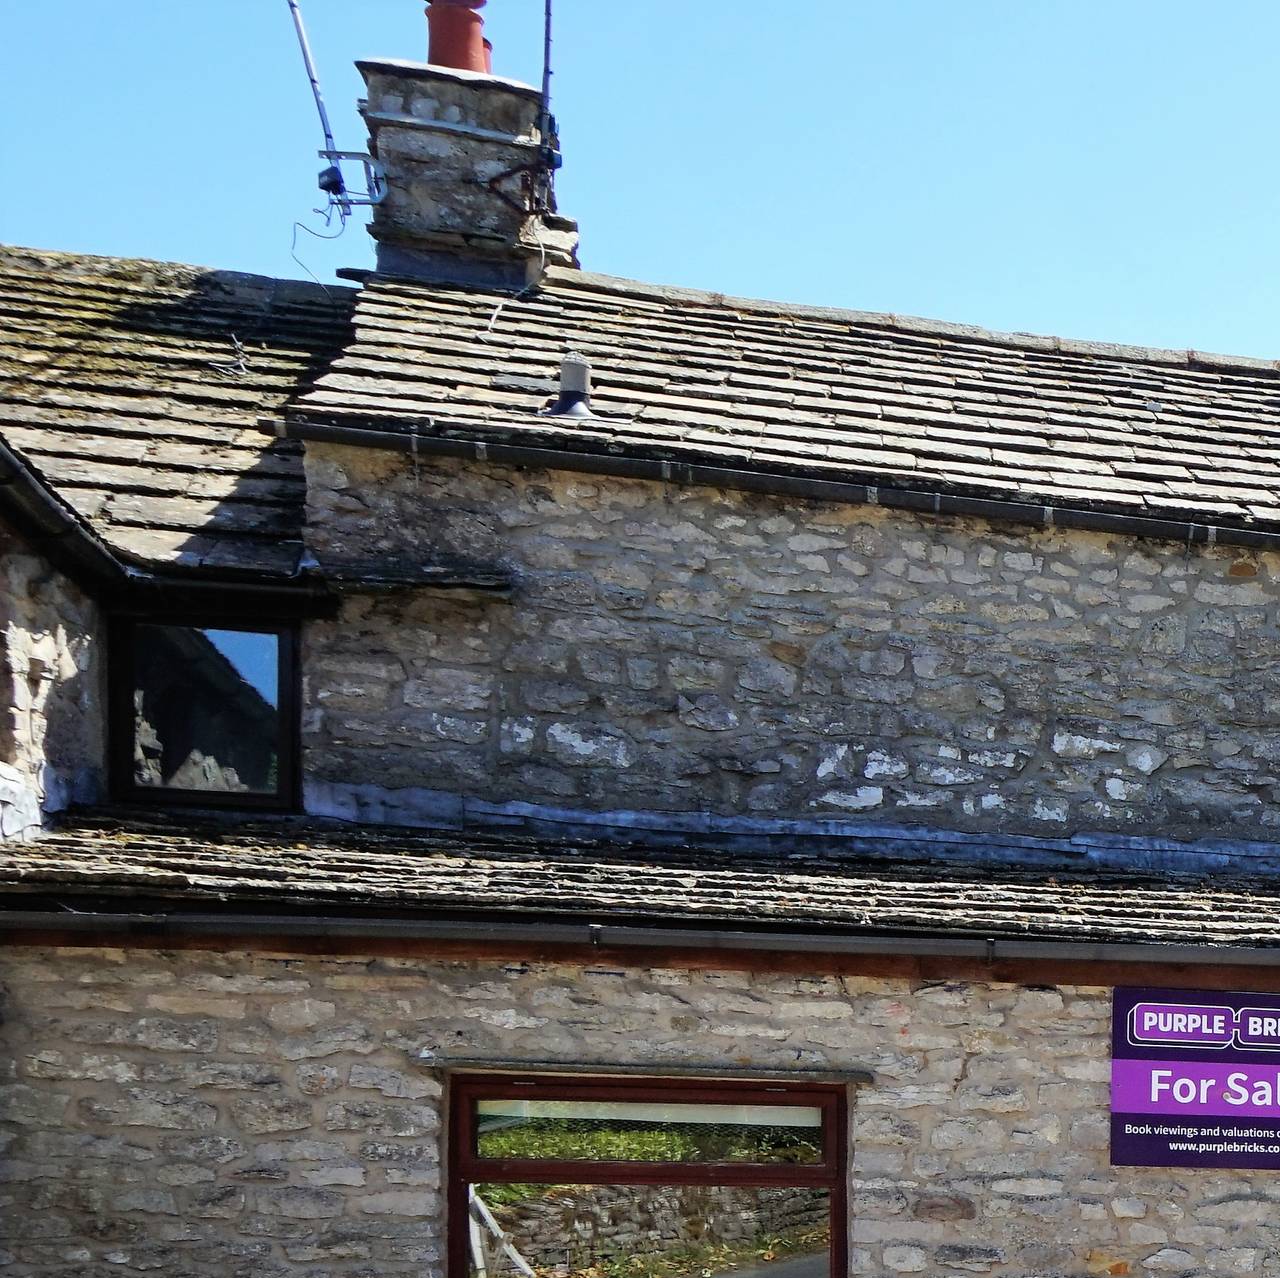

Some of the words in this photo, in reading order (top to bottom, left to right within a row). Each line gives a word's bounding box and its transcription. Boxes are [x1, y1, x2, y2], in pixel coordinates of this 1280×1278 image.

[1143, 1012, 1225, 1034] PURPLE
[1150, 1070, 1216, 1104] For
[1125, 1124, 1152, 1135] Book
[1153, 1125, 1199, 1138] viewings
[1200, 1126, 1220, 1137] and
[1222, 1127, 1275, 1139] valuations
